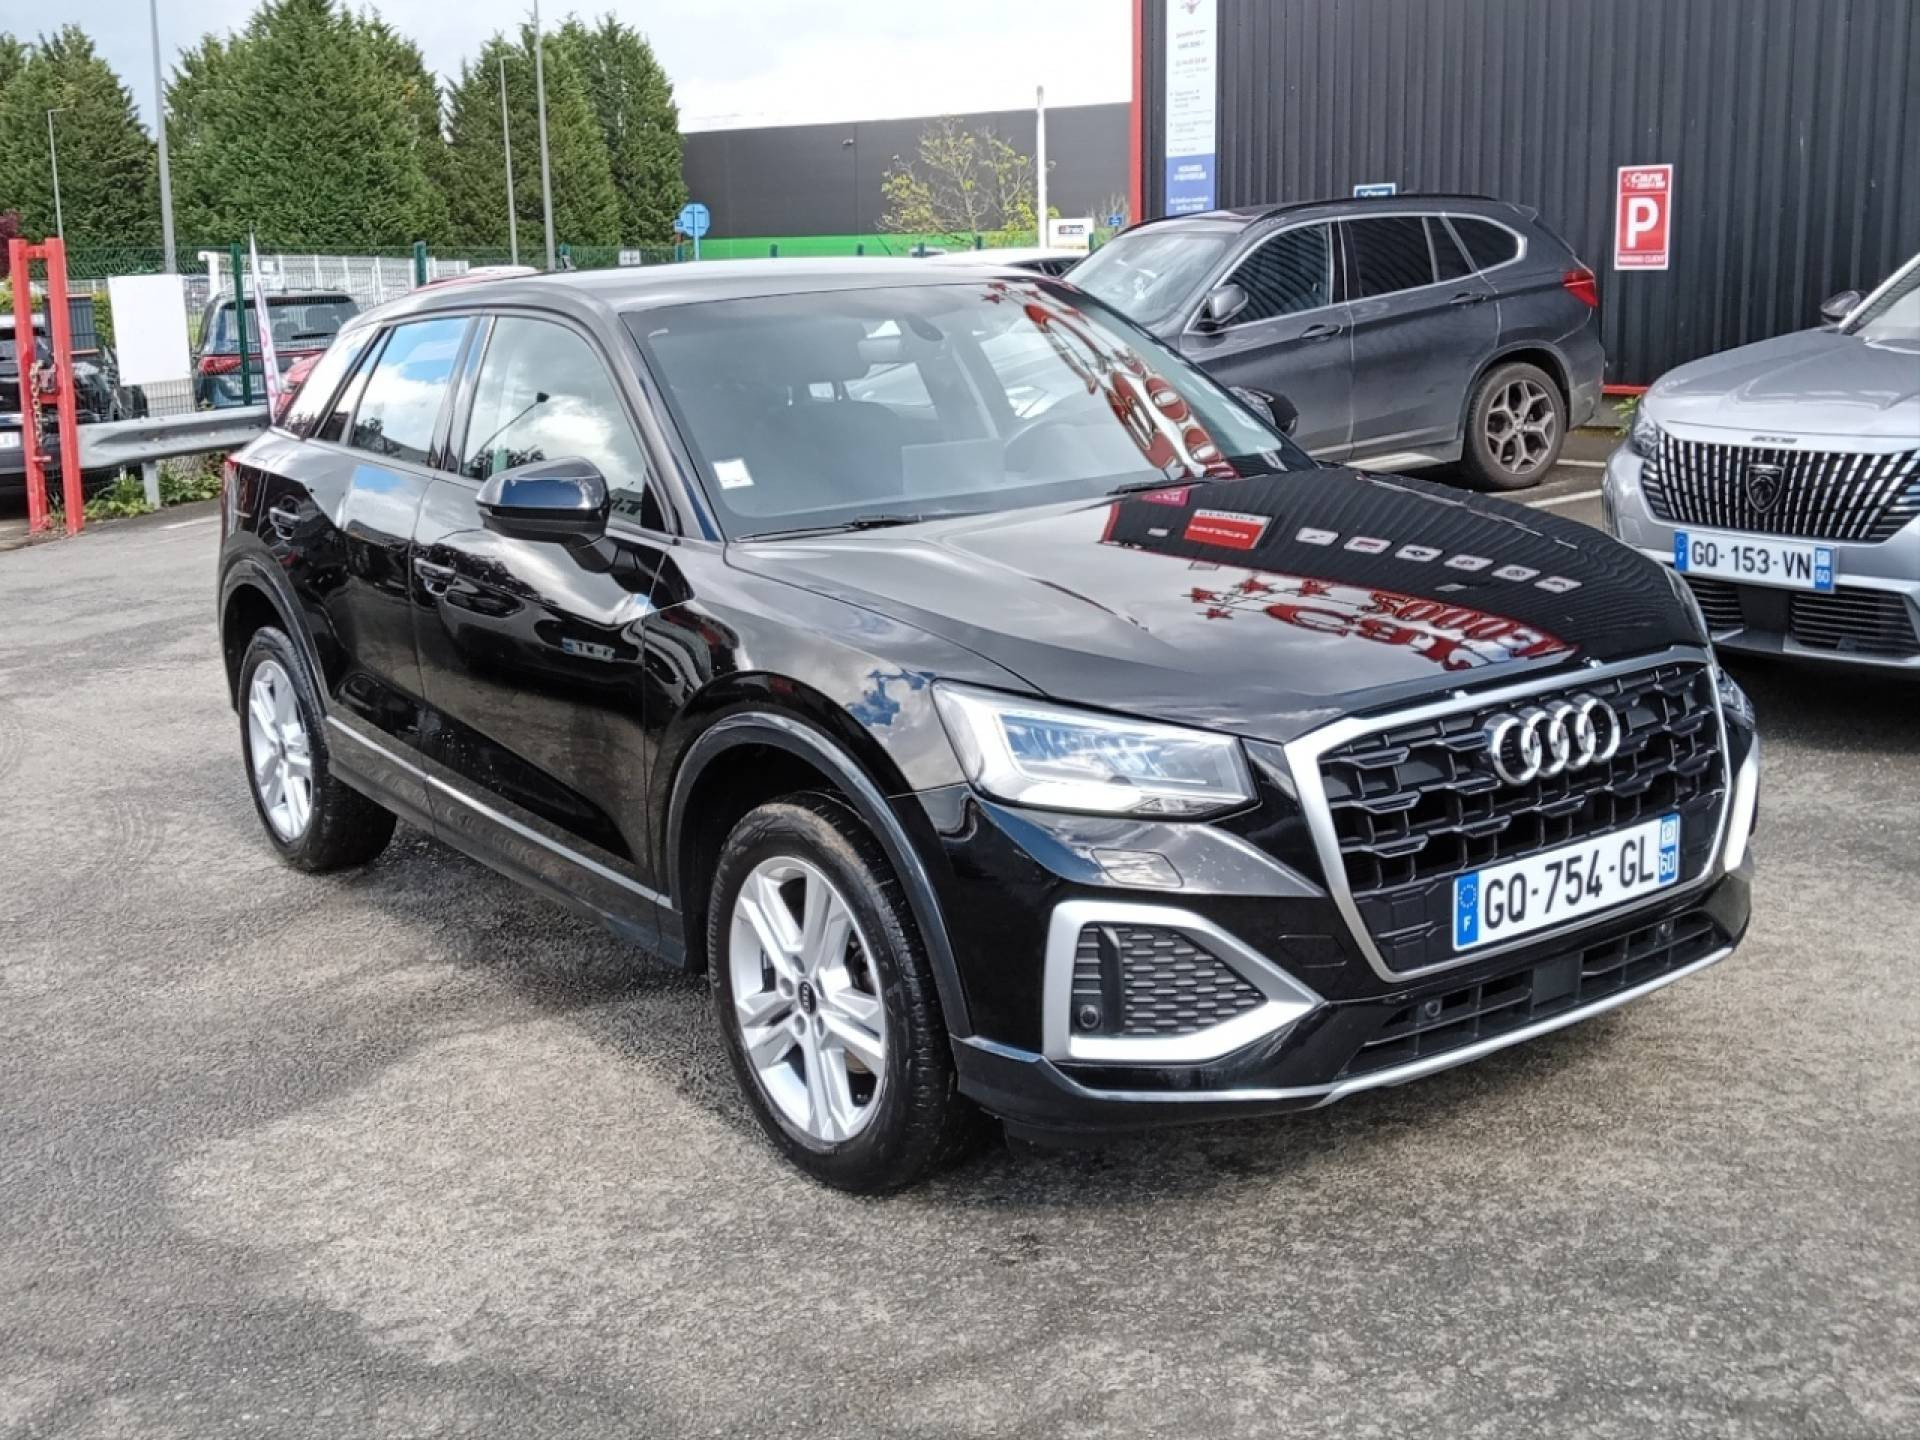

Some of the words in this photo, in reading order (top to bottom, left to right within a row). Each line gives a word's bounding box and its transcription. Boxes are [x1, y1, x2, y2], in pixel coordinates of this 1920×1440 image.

[1626, 197, 1660, 249] P
[1691, 540, 1812, 580] GQ-153-VN
[1484, 835, 1654, 930] GQ-754-GL
[1659, 851, 1675, 876] 60
[1463, 915, 1472, 932] F
